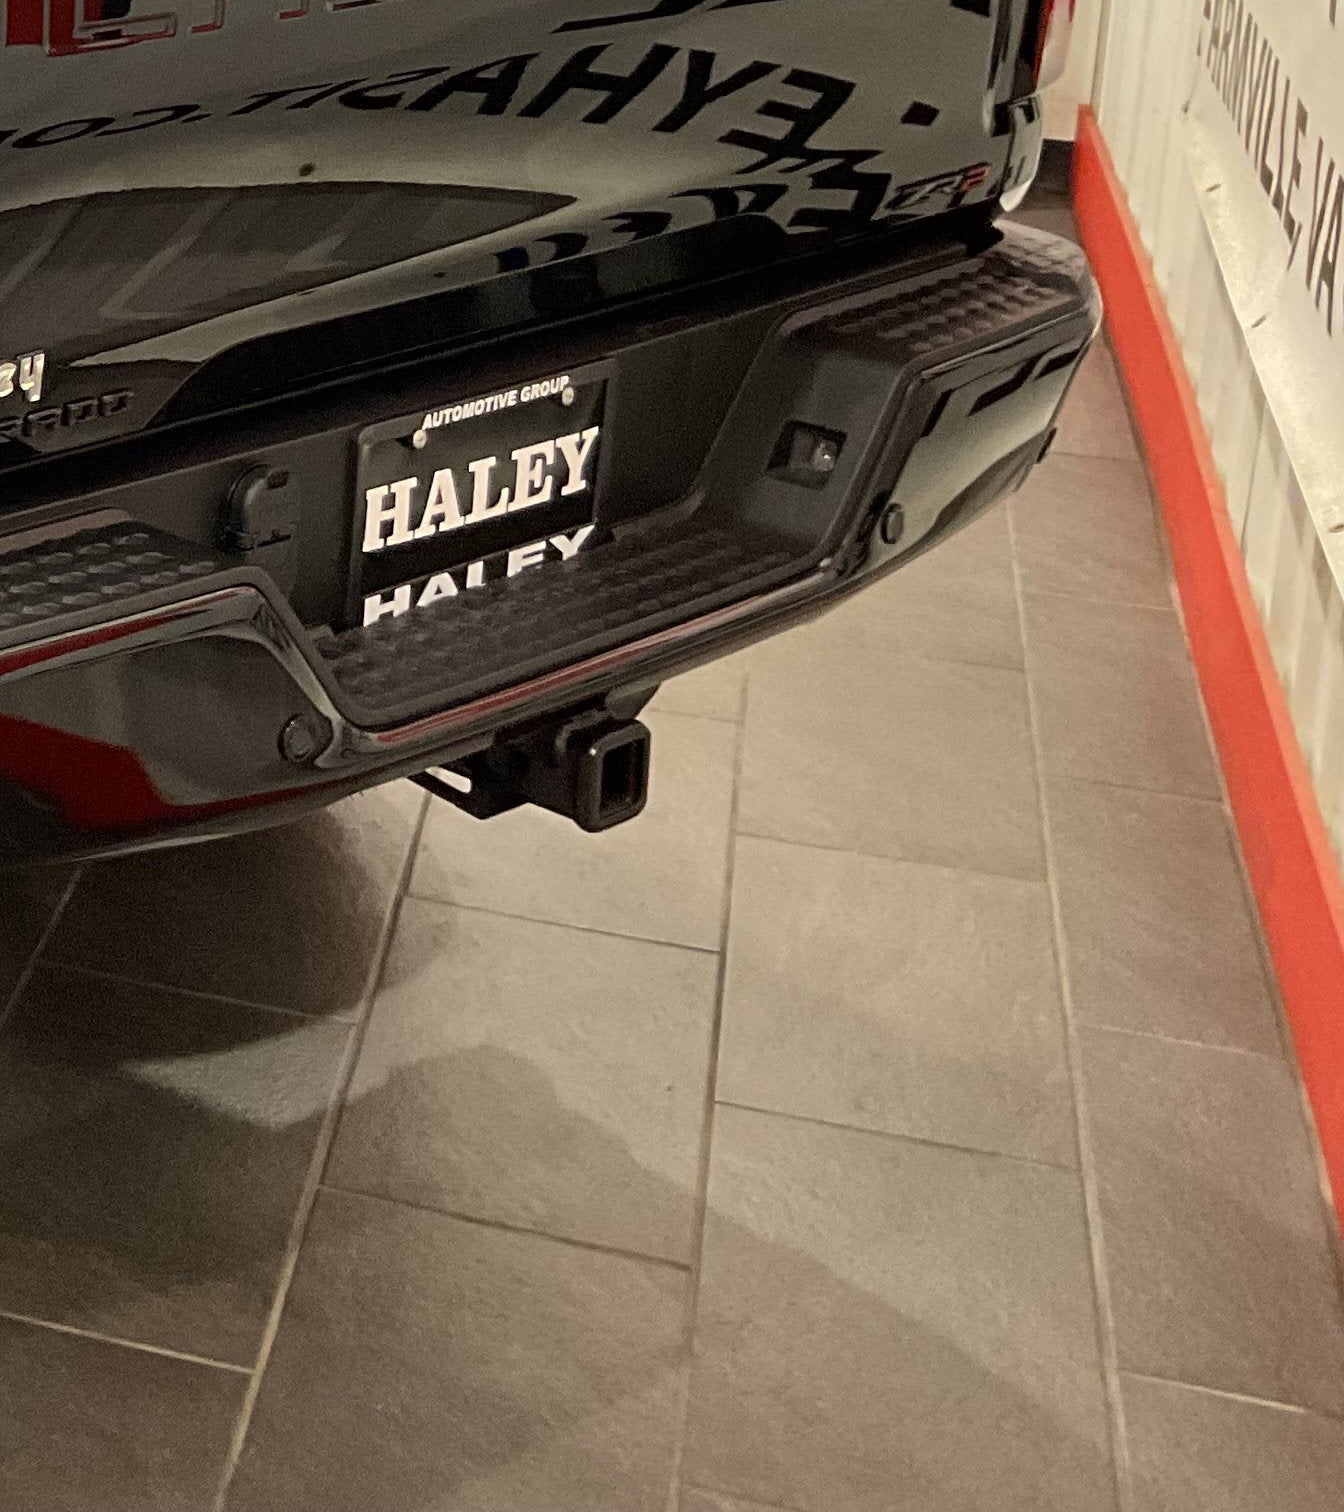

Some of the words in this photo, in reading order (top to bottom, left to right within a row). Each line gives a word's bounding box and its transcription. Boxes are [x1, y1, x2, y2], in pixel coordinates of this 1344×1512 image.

[422, 389, 518, 429] AUTOMOTIVE
[520, 375, 570, 403] GROUP
[362, 425, 600, 552] HALEY
